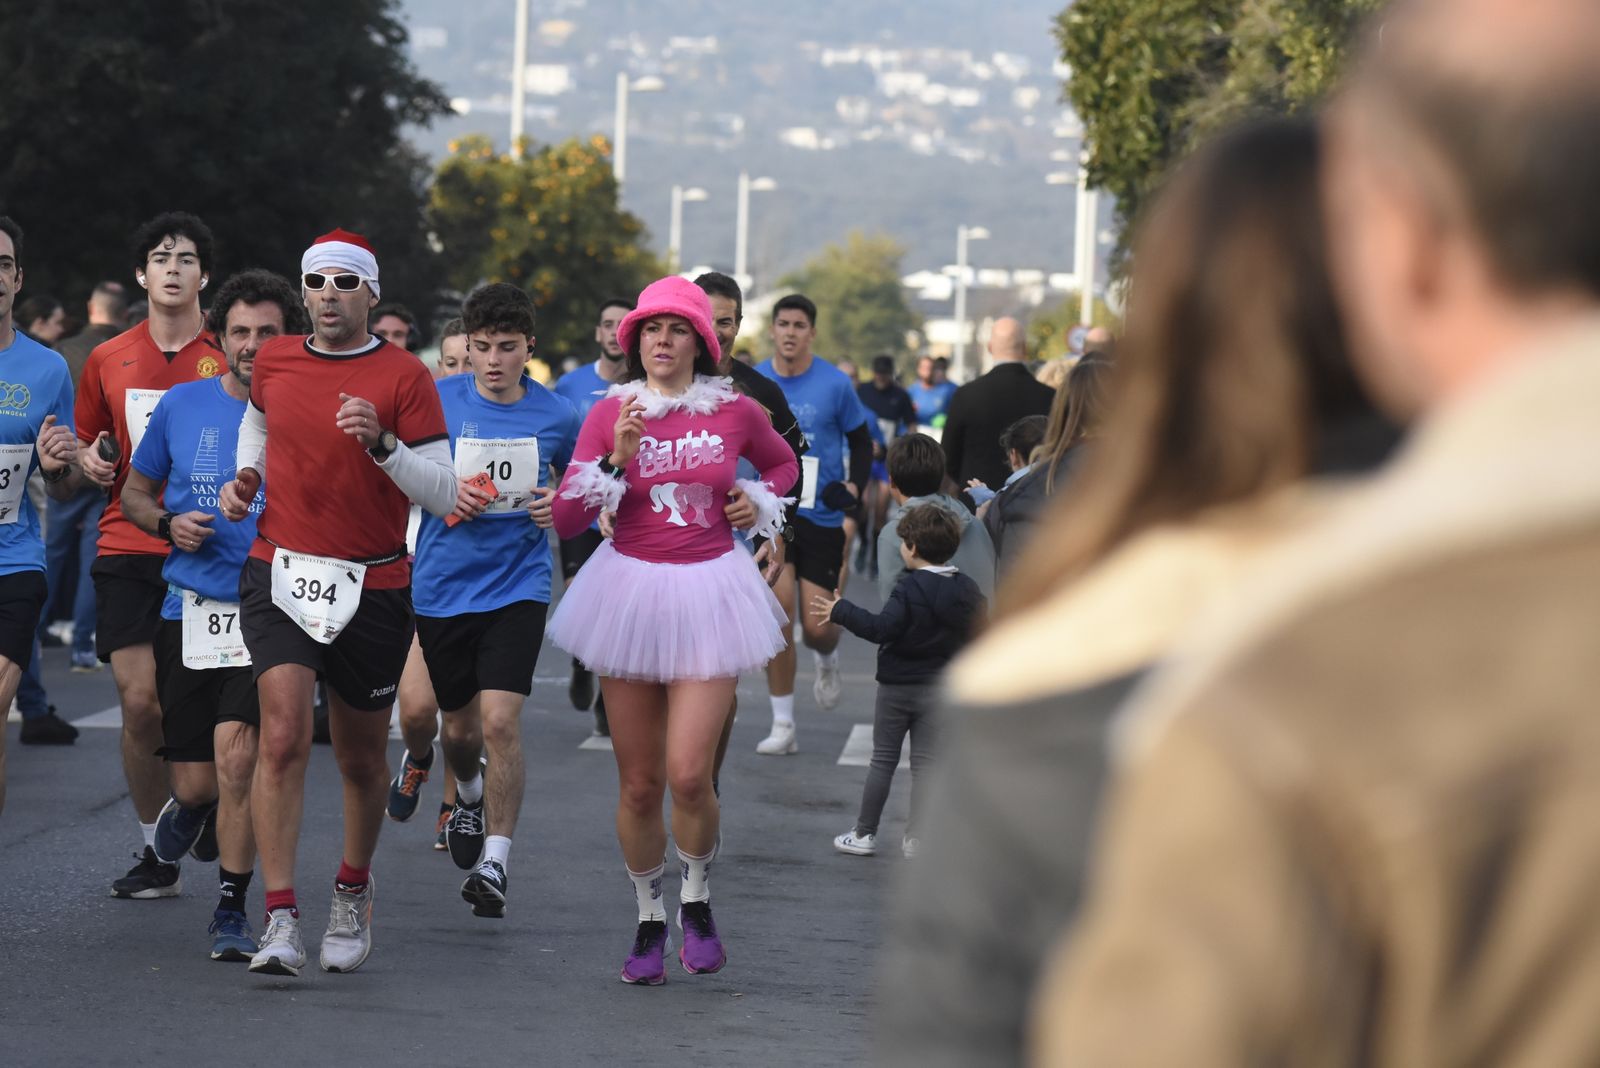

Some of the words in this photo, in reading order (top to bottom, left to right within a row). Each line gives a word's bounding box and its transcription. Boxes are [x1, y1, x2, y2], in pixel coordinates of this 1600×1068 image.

[190, 475, 215, 483] XXXIX
[486, 460, 512, 481] 10
[192, 484, 217, 495] SAN
[291, 577, 337, 605] 394
[208, 612, 240, 636] 87
[370, 684, 396, 698] Joma
